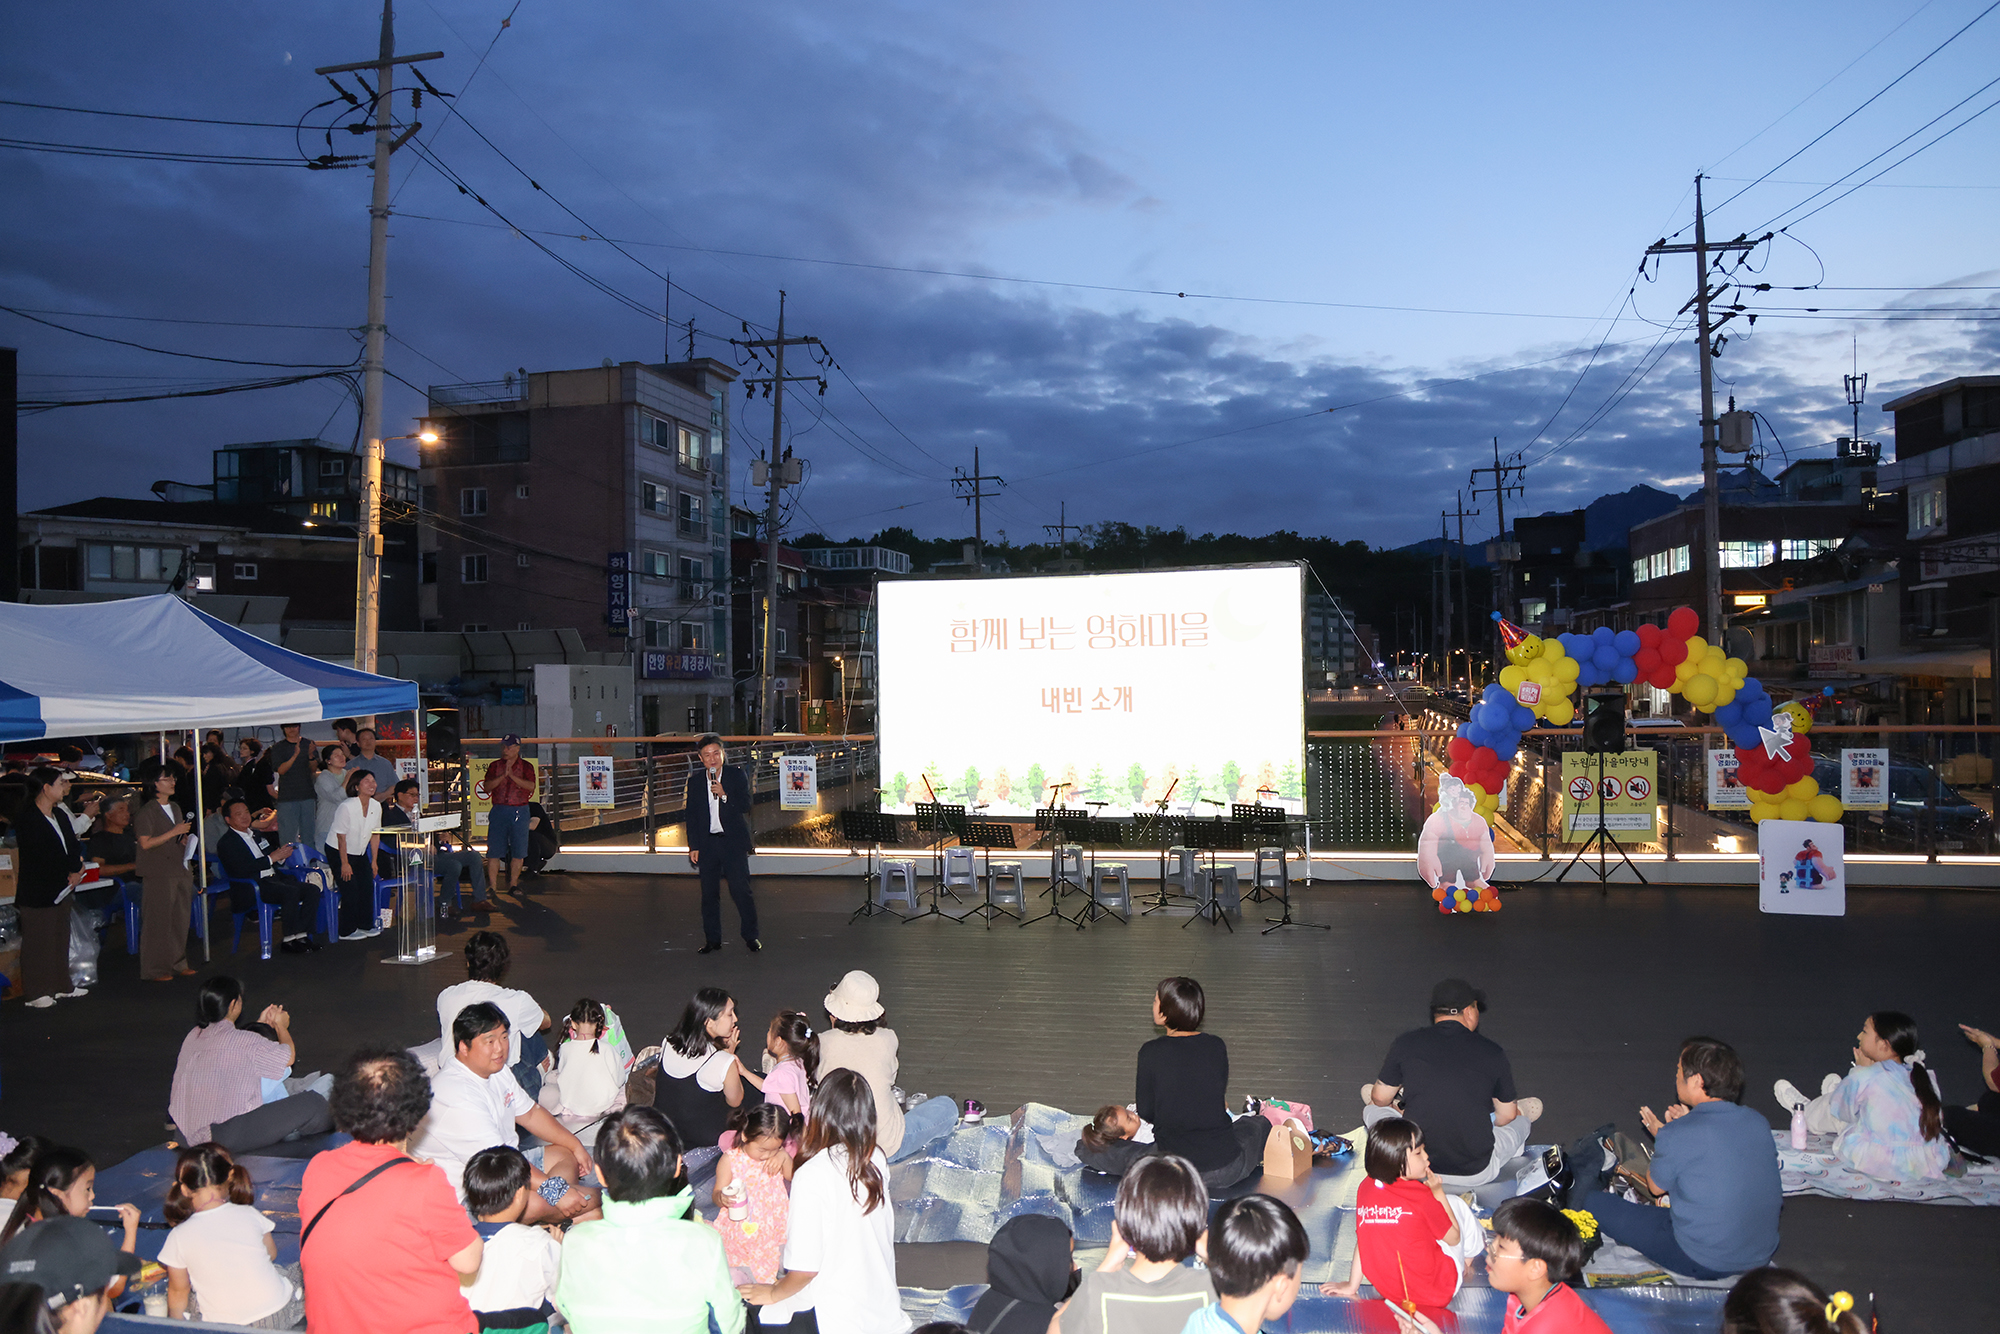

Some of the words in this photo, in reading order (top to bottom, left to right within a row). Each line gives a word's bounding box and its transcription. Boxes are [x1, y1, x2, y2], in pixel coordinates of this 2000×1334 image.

[950, 617, 1008, 653] 함께
[1018, 616, 1077, 651] 보는
[1086, 611, 1210, 650] 영화마을
[1041, 686, 1083, 714] 내빈
[1091, 686, 1133, 713] 소개
